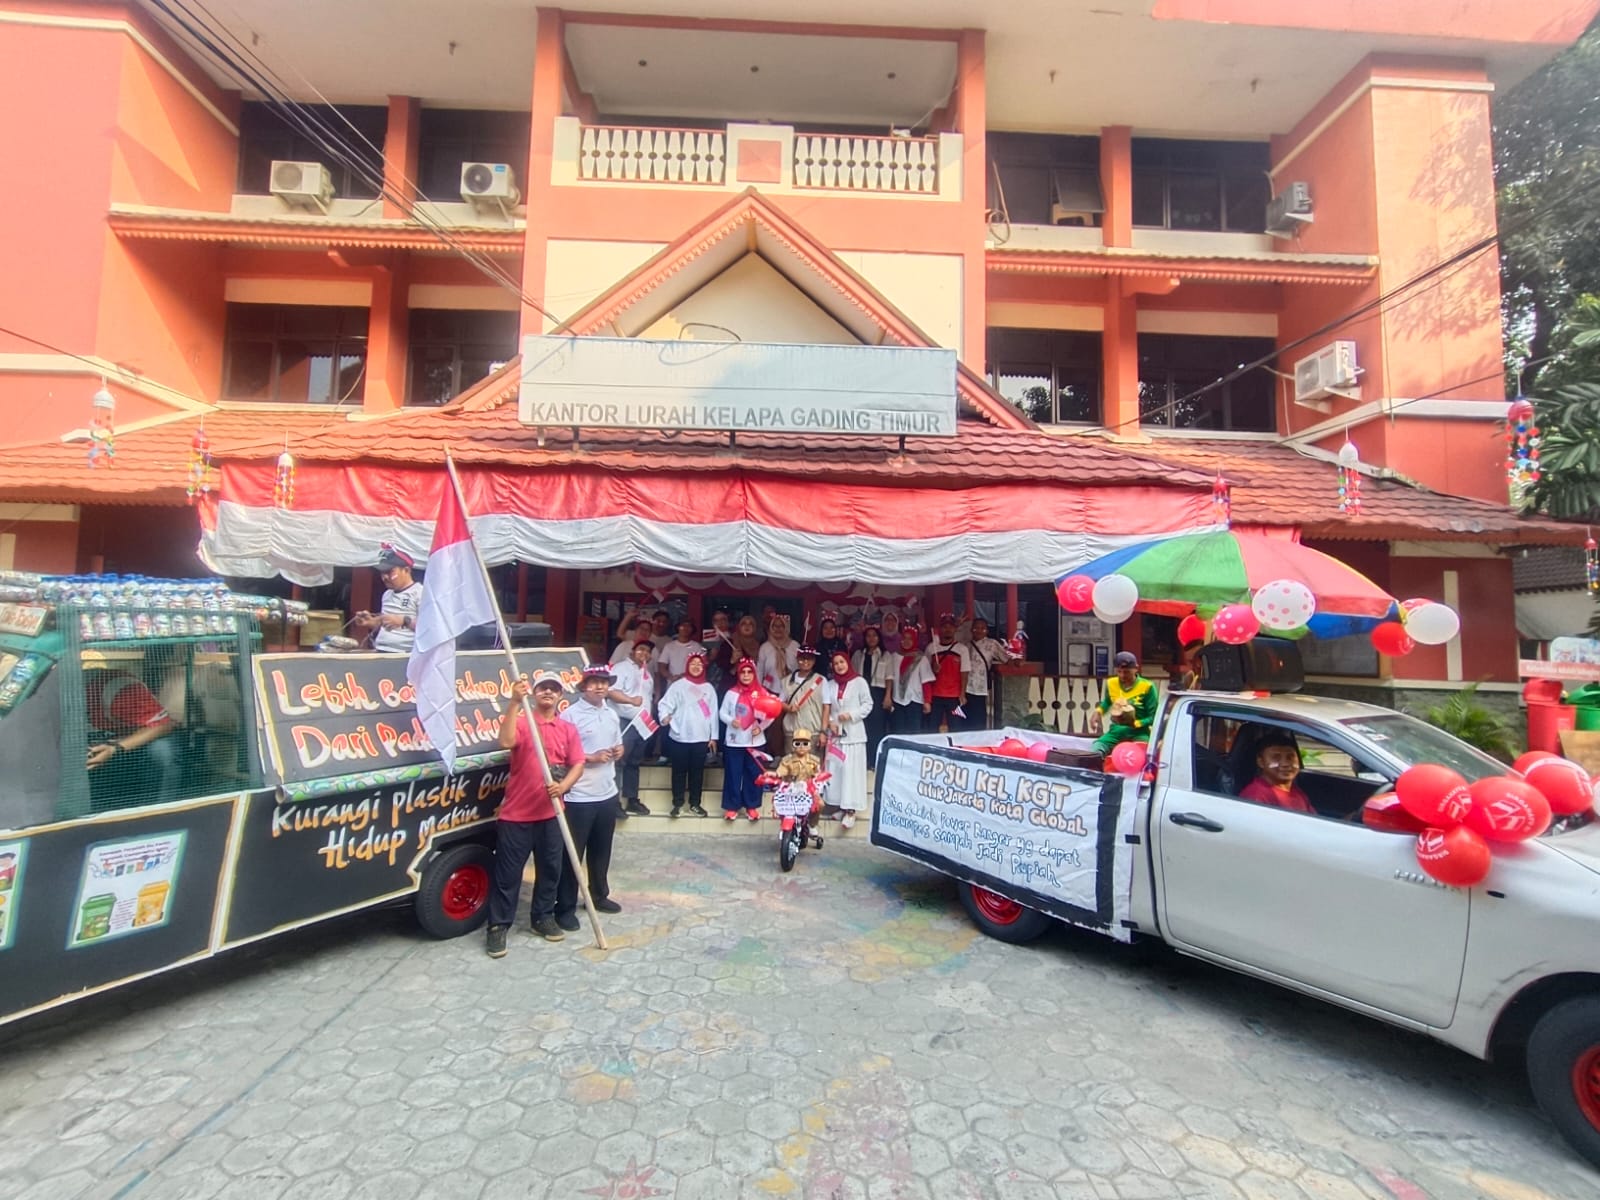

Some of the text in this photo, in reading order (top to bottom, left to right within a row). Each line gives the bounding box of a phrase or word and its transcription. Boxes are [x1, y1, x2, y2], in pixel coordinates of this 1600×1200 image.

[530, 401, 941, 433] KANTOR LURAH KELAPA GADING TIMUR
[271, 669, 379, 716] Lebih
[290, 724, 379, 769] Dari
[271, 791, 381, 838] Kurangi
[391, 774, 471, 829] plastik
[920, 756, 970, 791] PPSU
[1015, 775, 1072, 812] KGT
[317, 827, 407, 869] Hidup
[1039, 839, 1082, 868] dapat
